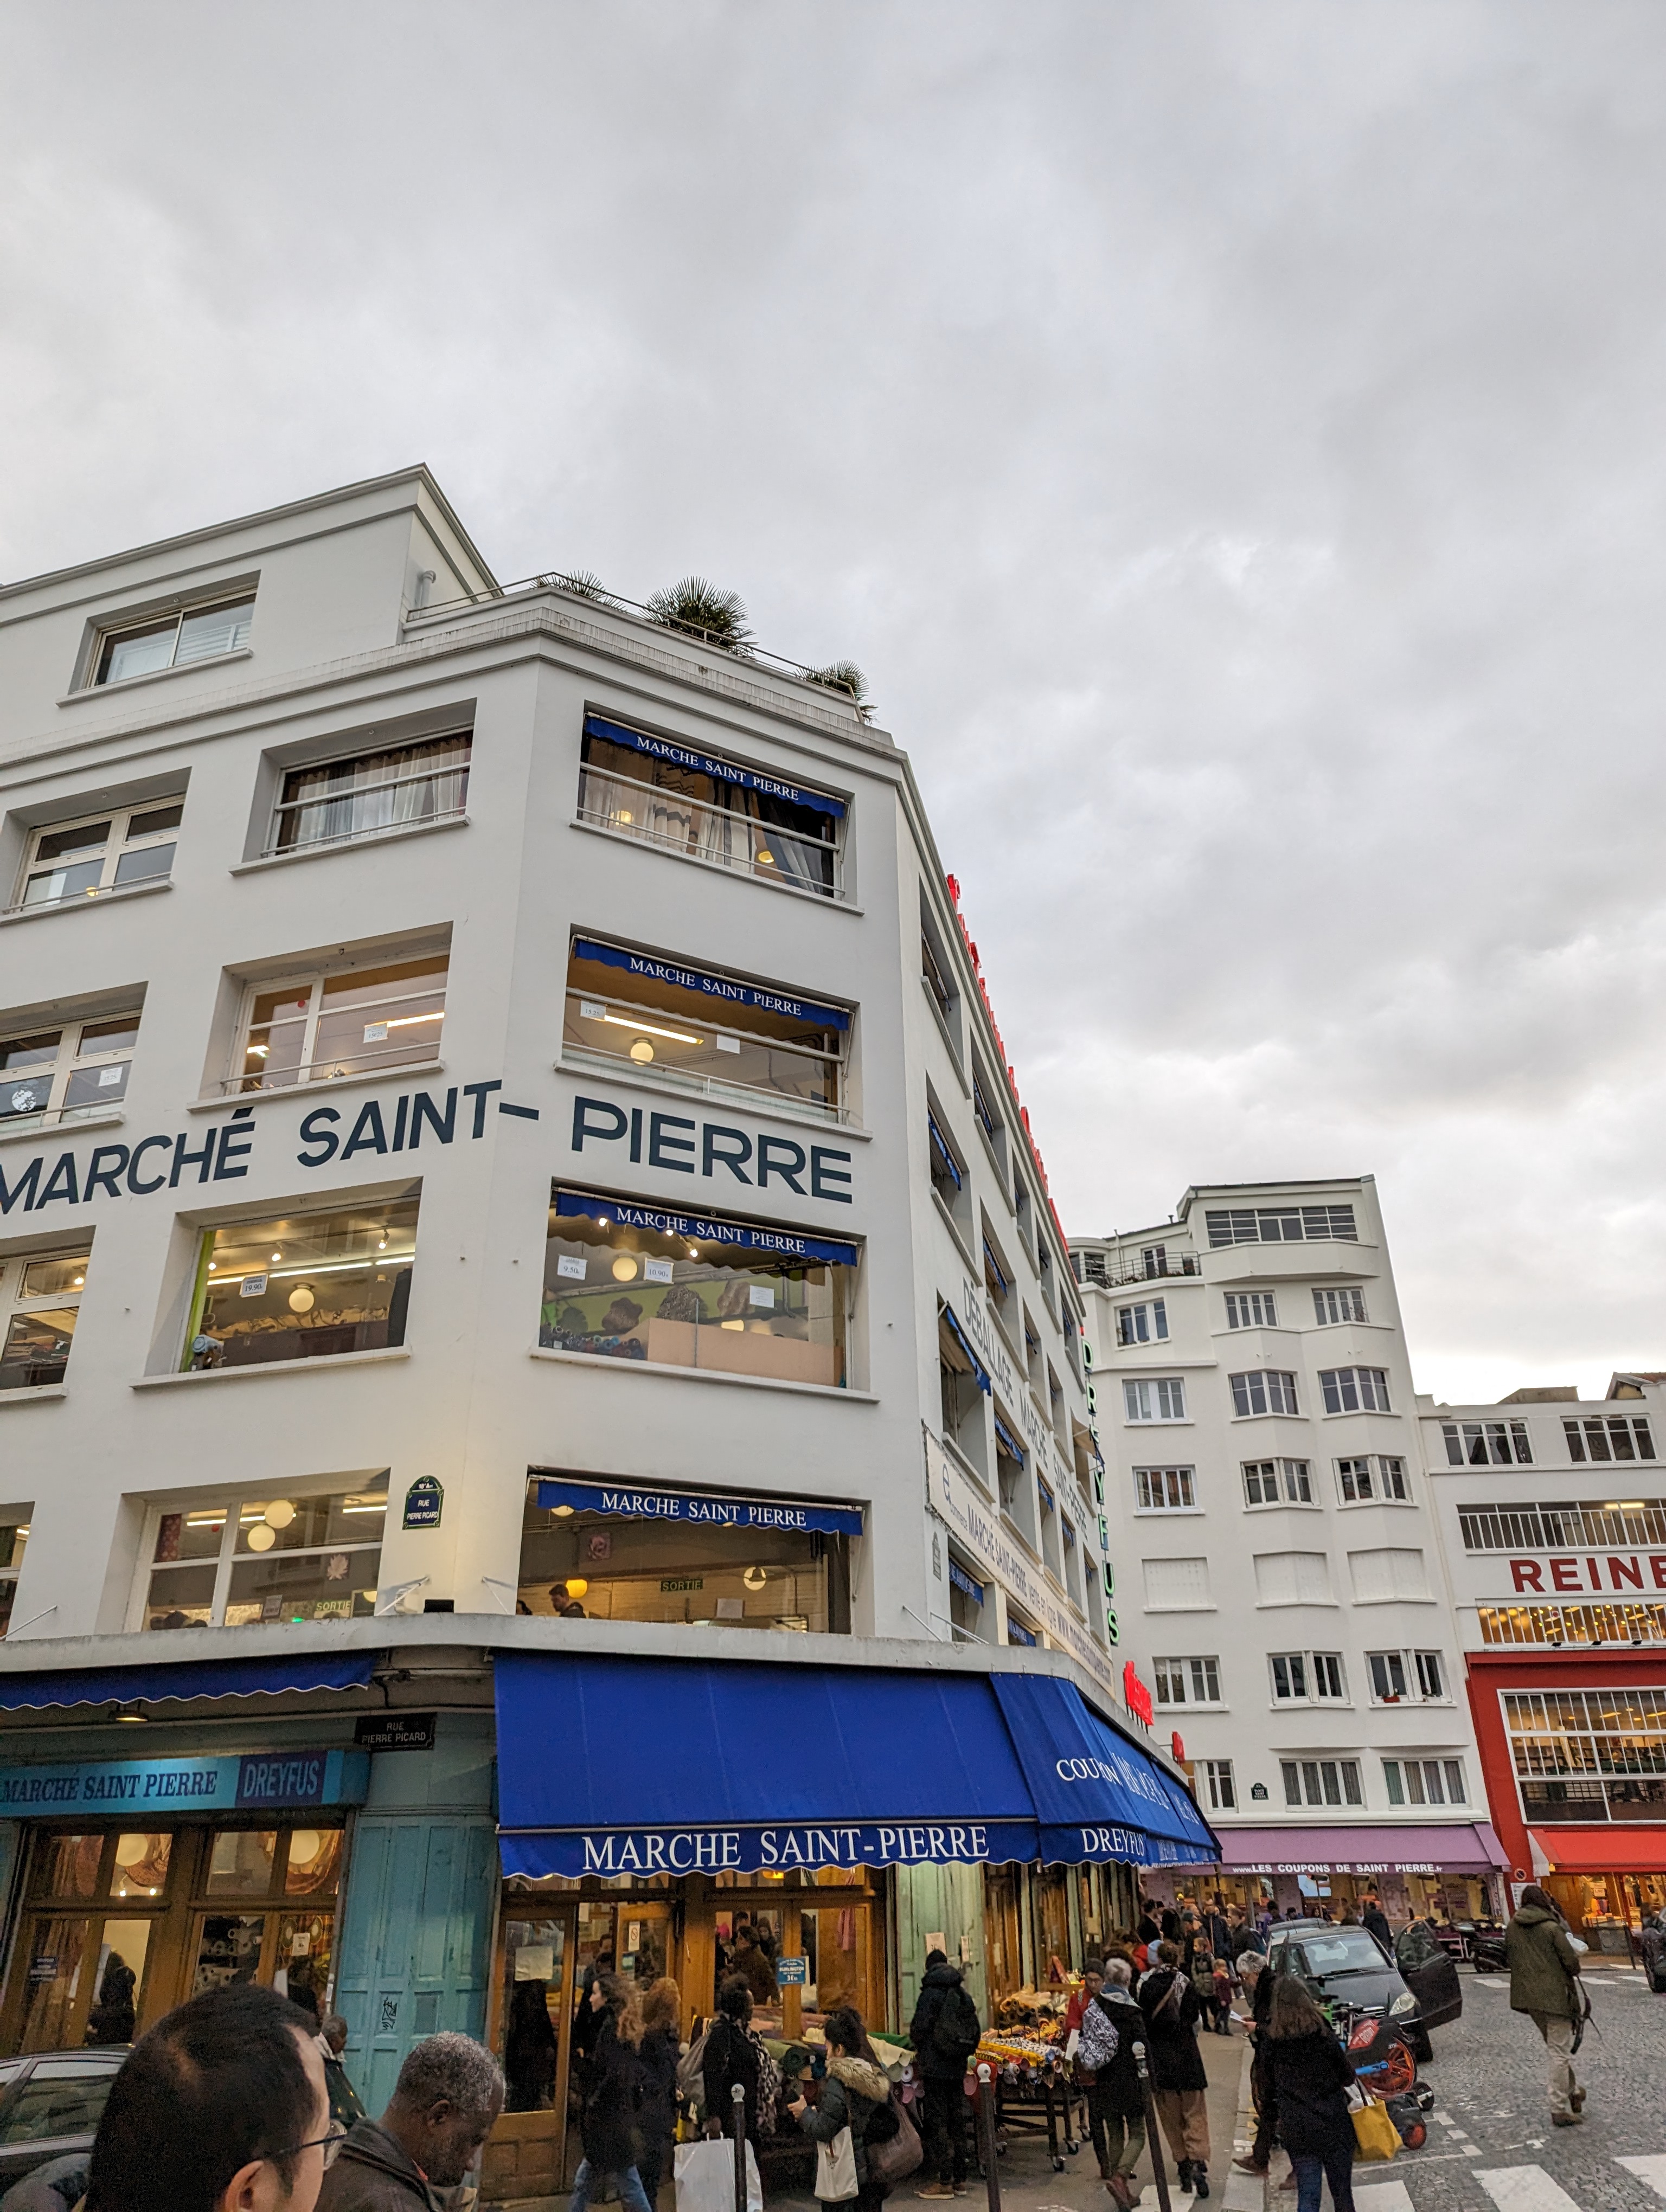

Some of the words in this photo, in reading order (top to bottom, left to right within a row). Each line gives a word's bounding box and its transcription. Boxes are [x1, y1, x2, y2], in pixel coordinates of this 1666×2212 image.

[637, 736, 699, 766] MARCHE
[705, 761, 746, 783] SAINT
[752, 776, 799, 801] PIERRE
[630, 957, 696, 986] MARCHE
[702, 979, 746, 1000] SAINT
[753, 992, 802, 1015] PIERRE
[0, 1107, 255, 1215] MARCHÉ
[572, 1095, 853, 1204] PIERRE
[617, 1207, 688, 1232] MARCHE
[696, 1221, 744, 1242] SAINT
[751, 1231, 806, 1253] PIERRE
[407, 1512, 422, 1520] PIERRE
[422, 1511, 438, 1519] PICARD
[418, 1499, 430, 1507] RUE
[601, 1491, 680, 1515] MARCHE
[689, 1501, 741, 1521] SAINT
[748, 1506, 807, 1526] PIERRE
[662, 1580, 701, 1591] SORTIE
[316, 1600, 351, 1611] SORTIE
[362, 1733, 393, 1743] PIERRE
[395, 1732, 426, 1742] PICARD
[387, 1722, 405, 1732] RUE
[1, 1769, 80, 1803] MARCHÉ
[82, 1774, 140, 1801] SAINT
[143, 1770, 218, 1798] PIERRE
[242, 1760, 320, 1798] DREYFUS
[581, 1832, 741, 1870] MARCHE
[760, 1826, 991, 1865] SAINT-PIERRE
[1080, 1828, 1144, 1856] DREYFUS
[1278, 1864, 1330, 1873] COUPONS
[1336, 1864, 1351, 1873] DE
[1356, 1864, 1389, 1873] SAINT
